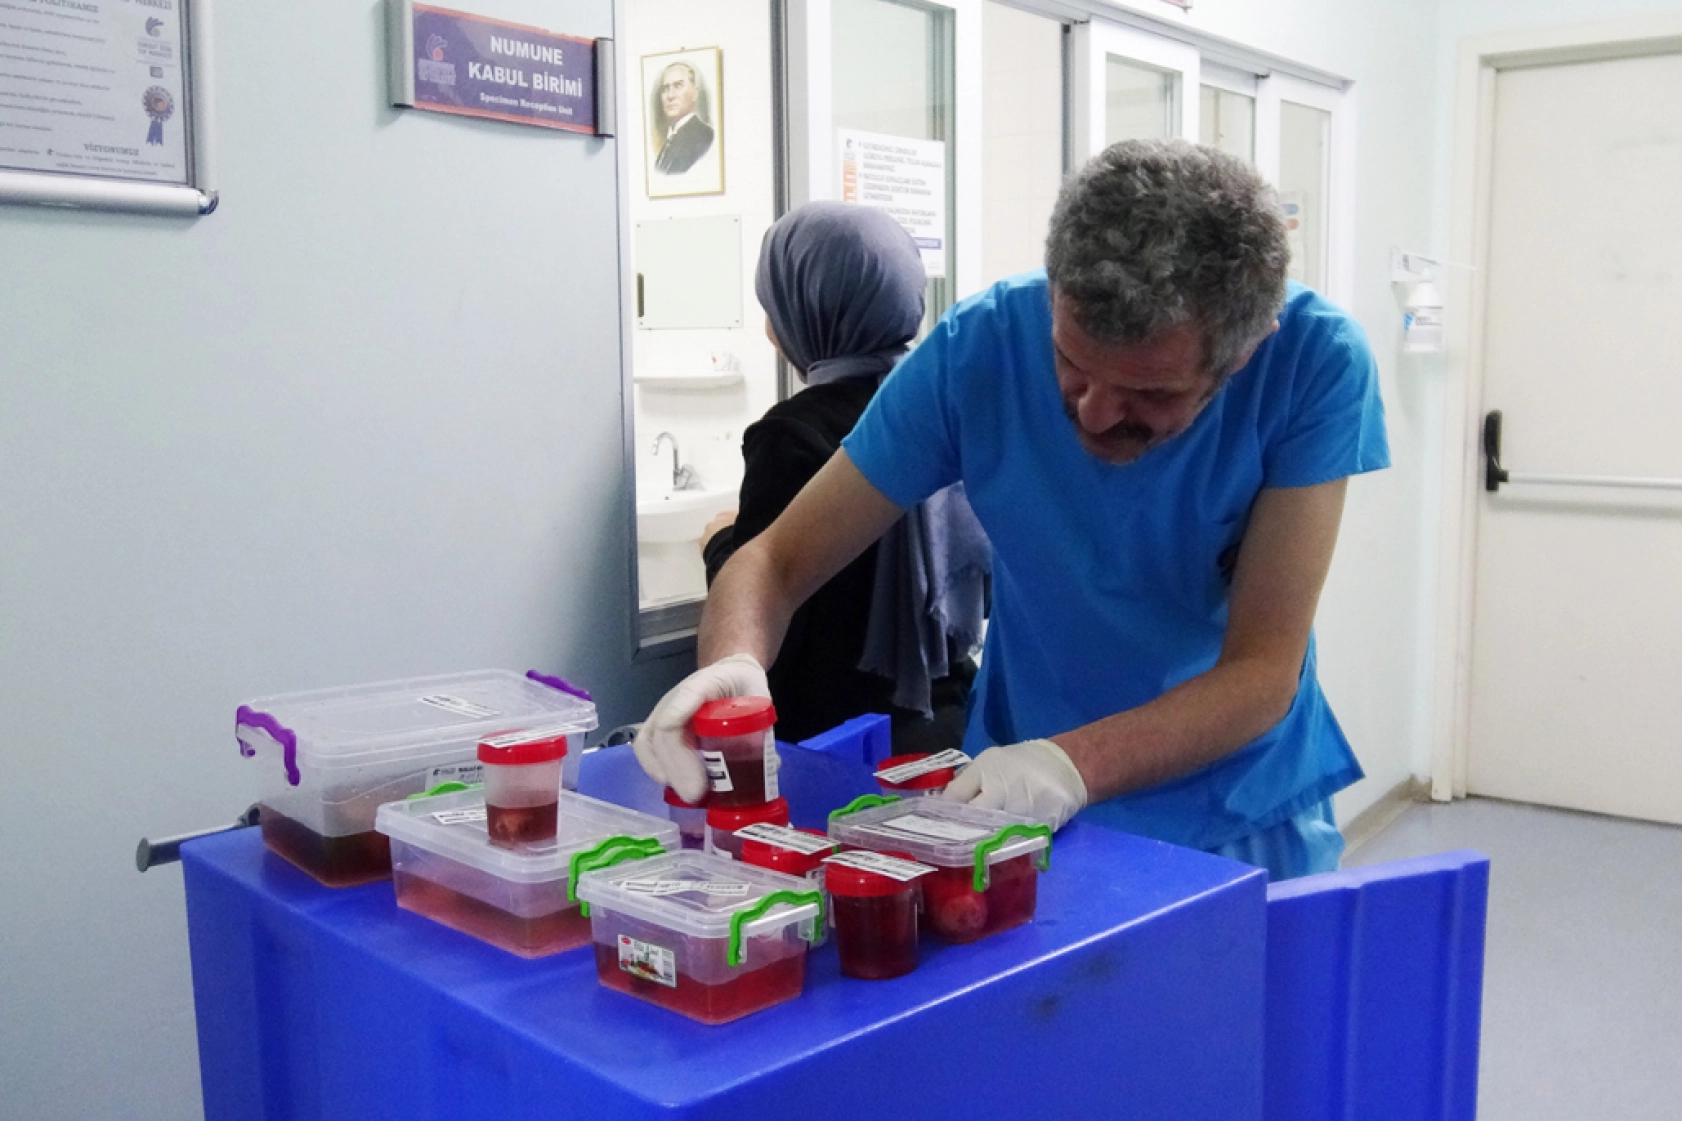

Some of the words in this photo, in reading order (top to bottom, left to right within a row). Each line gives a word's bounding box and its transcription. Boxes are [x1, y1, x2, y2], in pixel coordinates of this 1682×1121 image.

[490, 36, 563, 65] NUMUNE
[468, 61, 528, 87] KABUL
[532, 71, 582, 97] BİRİMİ
[480, 92, 519, 106] Specimen
[520, 98, 556, 111] Reception
[558, 105, 573, 116] Unit
